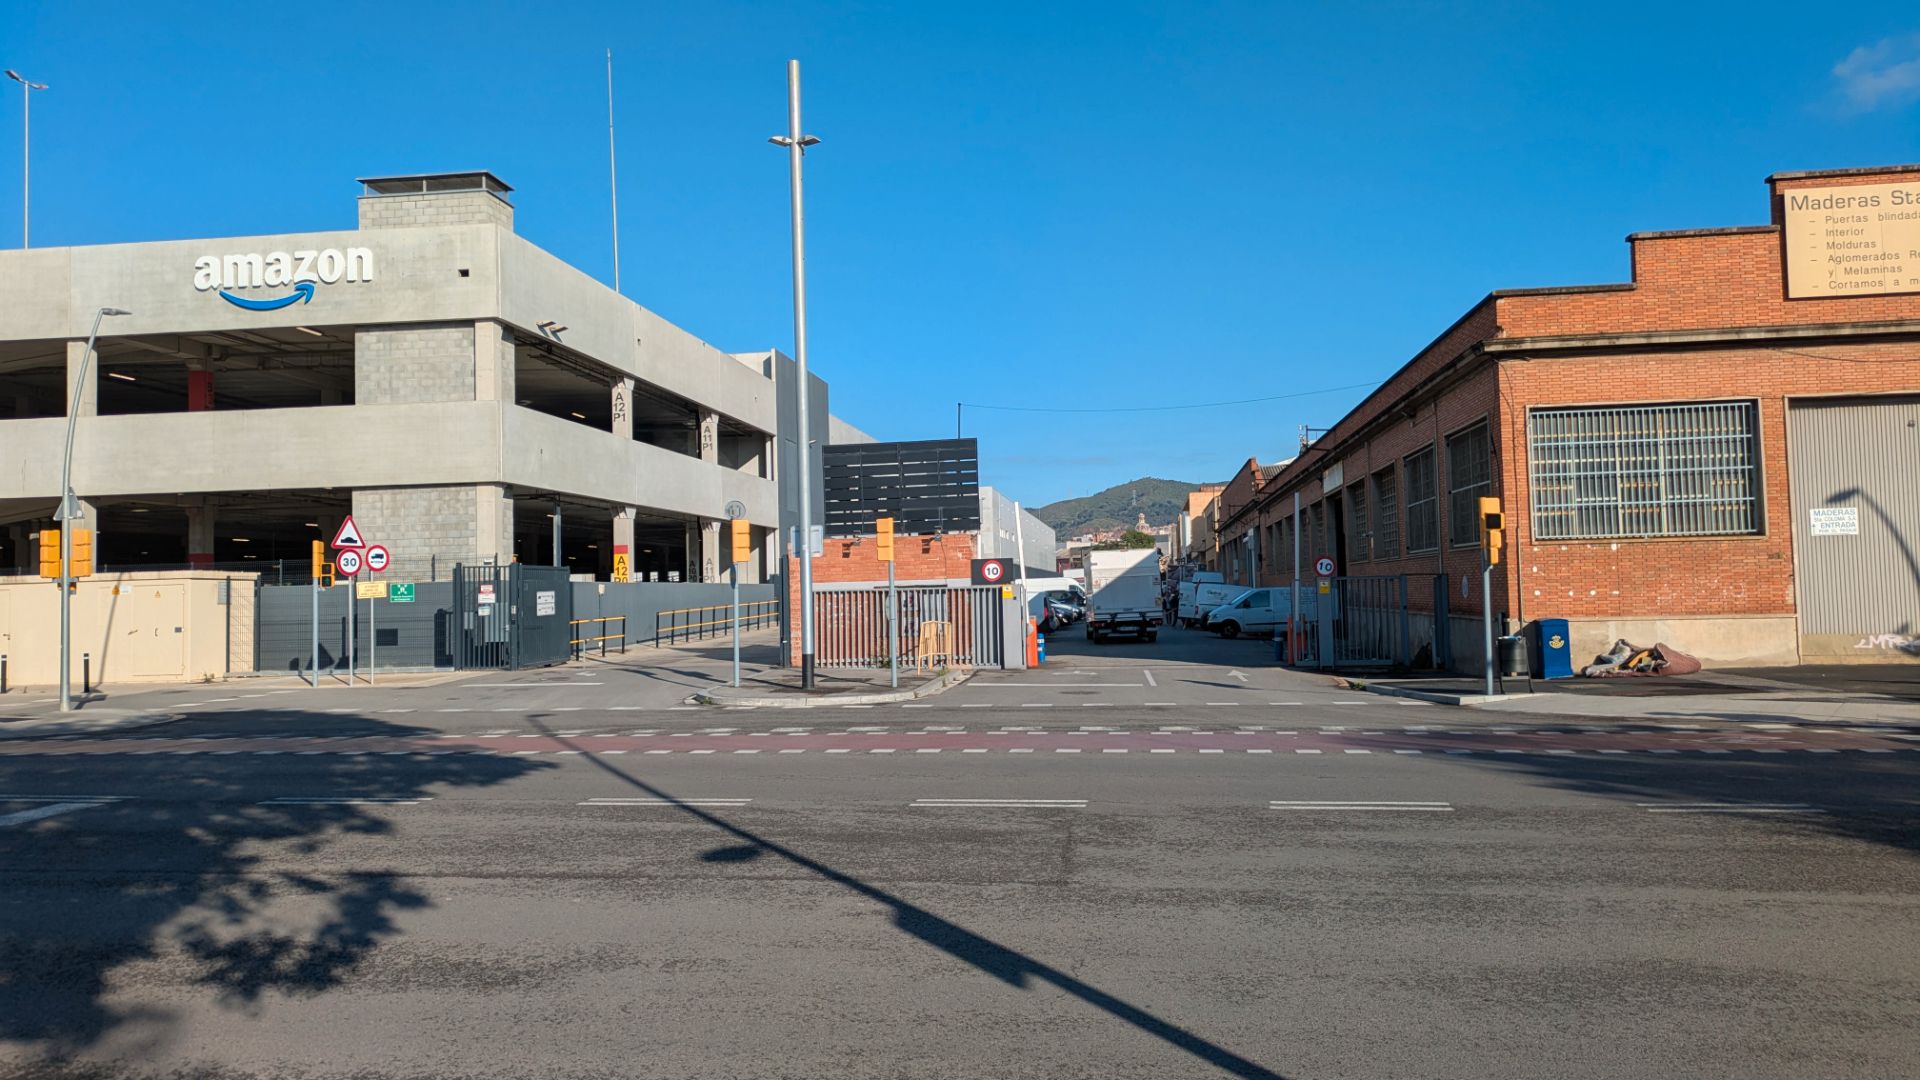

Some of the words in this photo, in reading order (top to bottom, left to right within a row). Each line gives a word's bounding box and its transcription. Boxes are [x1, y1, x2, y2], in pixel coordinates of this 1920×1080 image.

[1791, 194, 1880, 211] Maderas
[1825, 215, 1869, 225] Puertas
[1878, 211, 1920, 222] blindad
[1825, 228, 1865, 237] Interior
[1826, 241, 1877, 251] Molduras
[1828, 253, 1901, 265] Aglomerados
[194, 247, 374, 291] amazon
[1828, 270, 1834, 278] y
[1844, 266, 1903, 276] Melaminas
[1829, 280, 1884, 290] Cortamos
[615, 392, 624, 401] A
[614, 403, 625, 412] 12
[613, 413, 626, 422] P1
[343, 558, 356, 567] 30
[617, 556, 625, 565] A
[1319, 562, 1332, 571] 10
[615, 567, 628, 576] 12
[986, 567, 999, 576] 10
